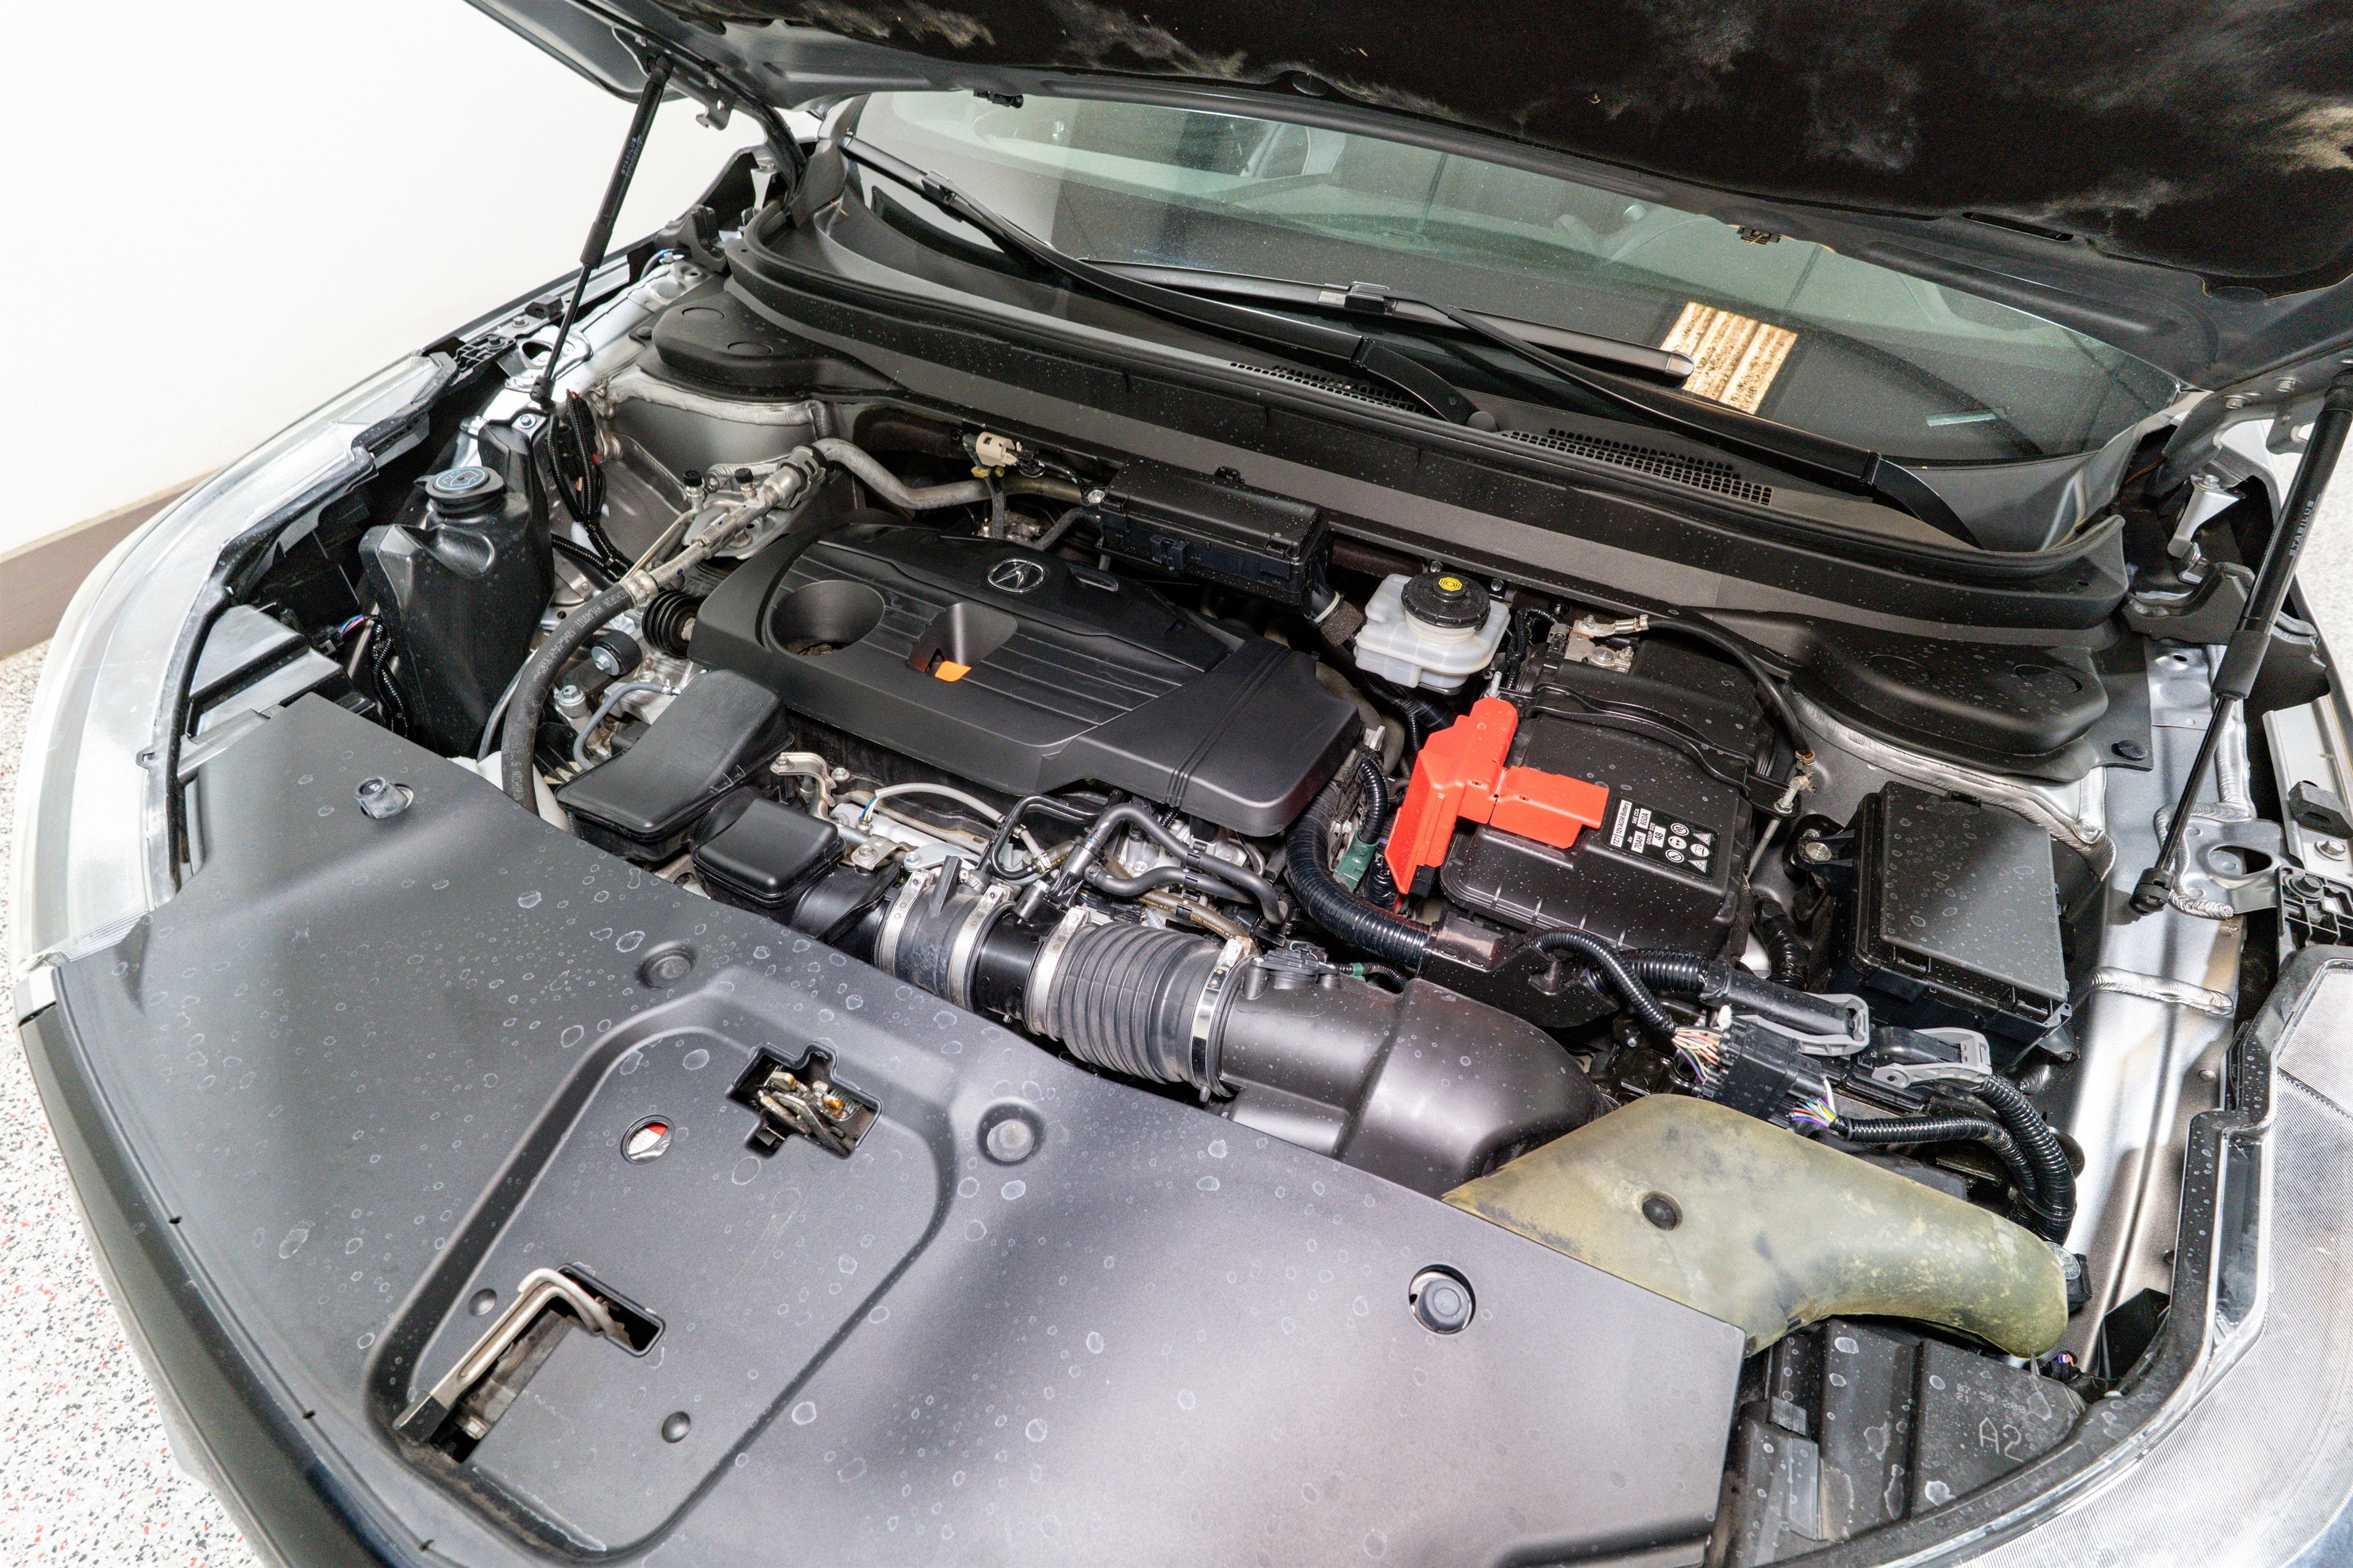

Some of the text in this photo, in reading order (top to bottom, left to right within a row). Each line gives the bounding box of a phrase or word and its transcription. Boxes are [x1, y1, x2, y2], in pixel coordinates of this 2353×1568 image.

[2289, 500, 2314, 557] STABILUS
[1613, 836, 1621, 845] TZ7
[1621, 802, 1630, 816] Battery
[1640, 813, 1649, 826] 650A
[1634, 835, 1644, 849] 70AH
[1654, 832, 1664, 841] 48
[1978, 1417, 2024, 1462] A2
